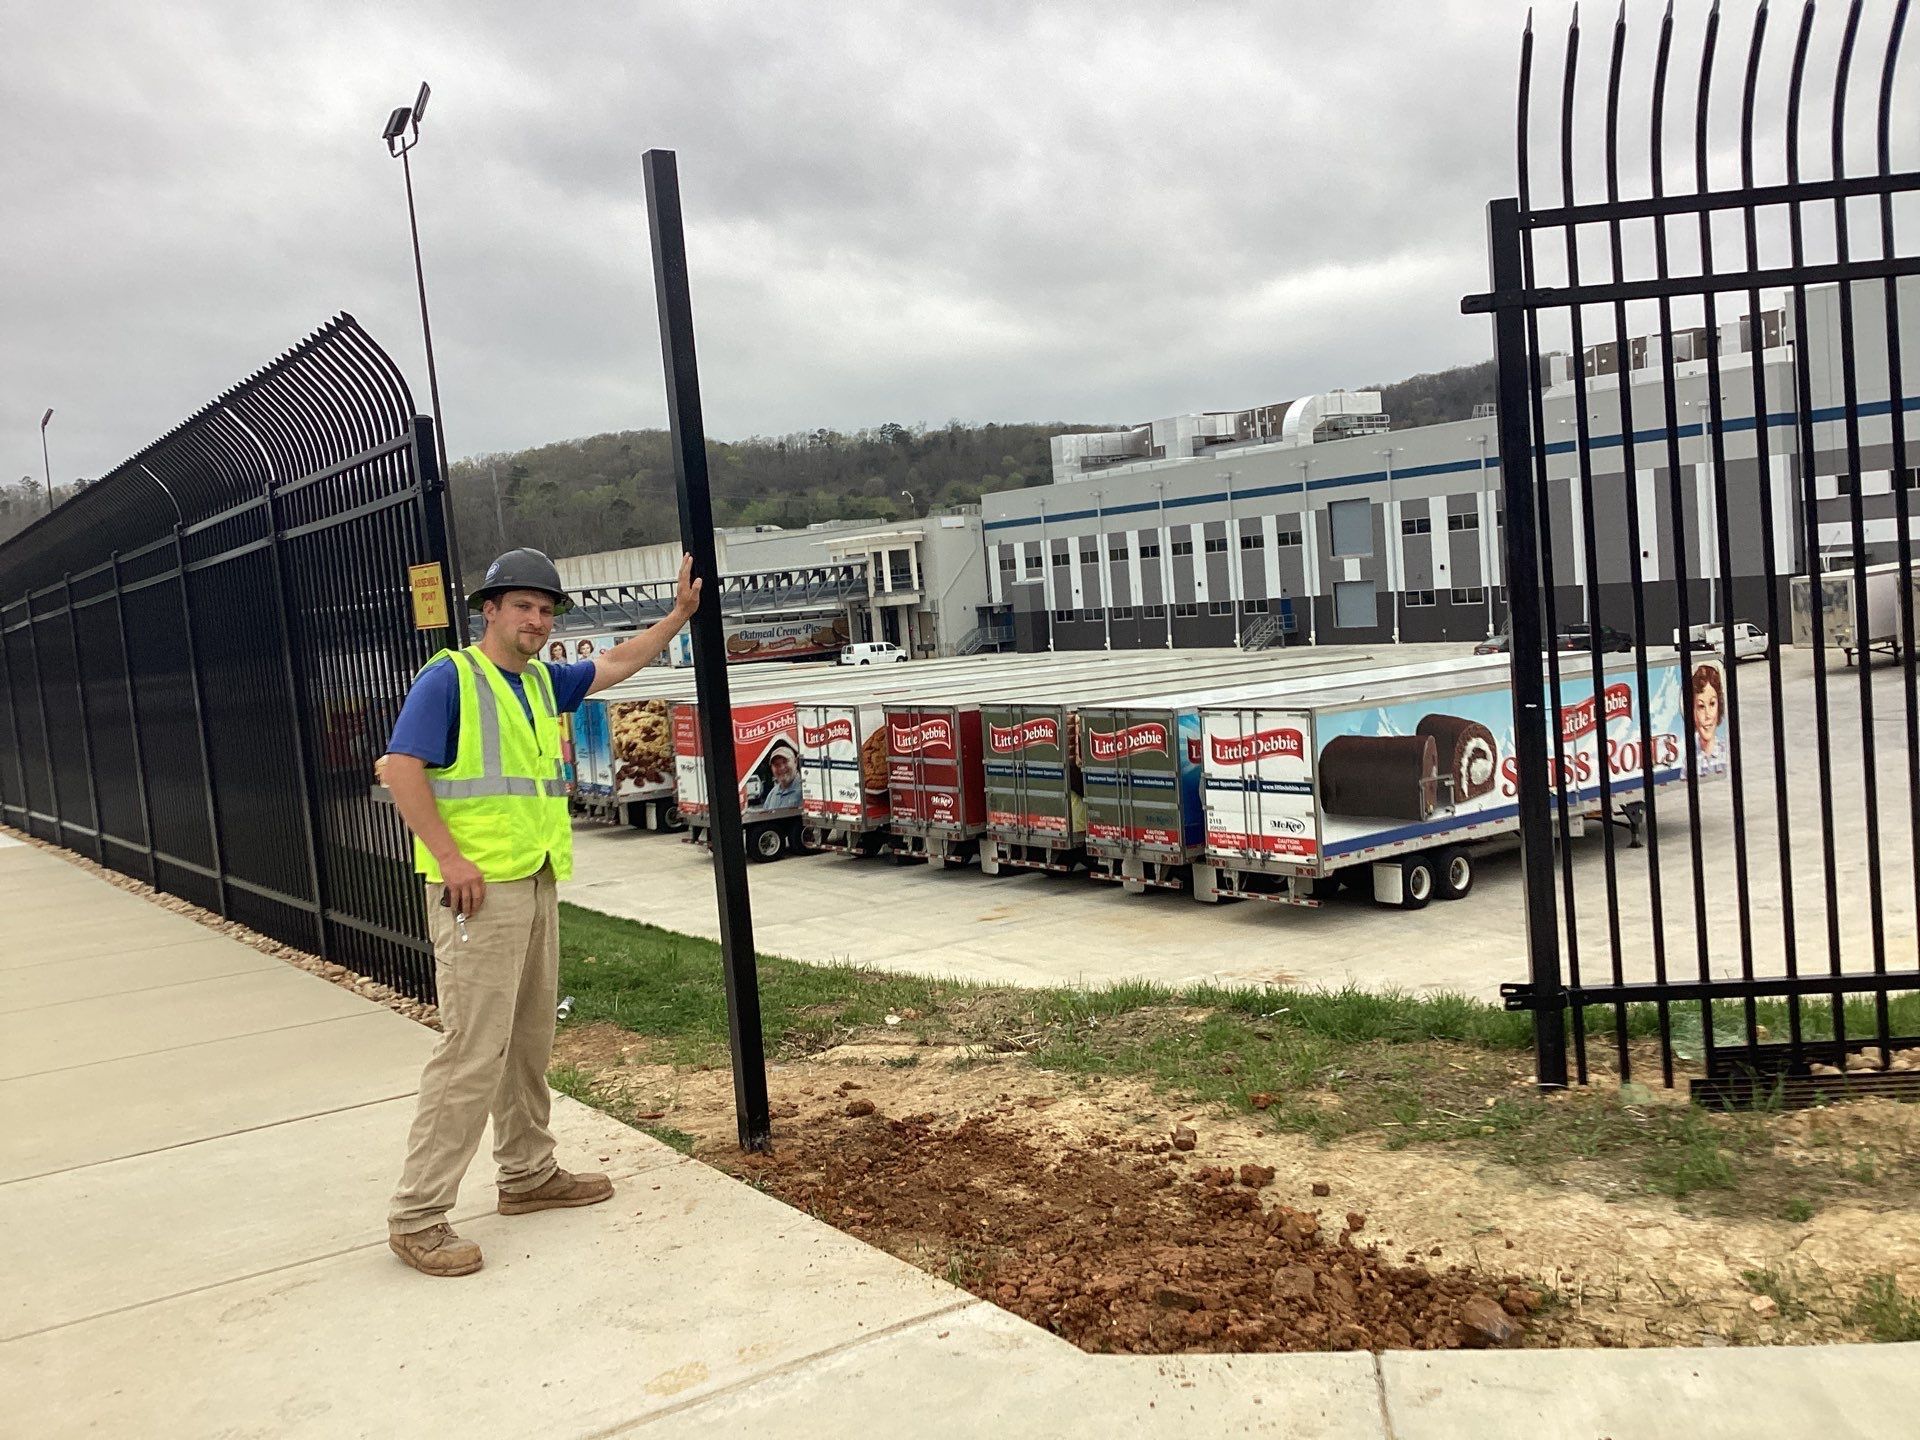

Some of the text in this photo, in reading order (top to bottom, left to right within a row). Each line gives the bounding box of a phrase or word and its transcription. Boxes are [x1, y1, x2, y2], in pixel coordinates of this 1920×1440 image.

[739, 623, 821, 641] Oatmeal Creme Pies
[738, 713, 797, 740] Little Debbi
[896, 734, 918, 747] Litte
[994, 734, 1019, 747] Litte
[1094, 740, 1123, 754] Litte
[1215, 743, 1250, 760] Little
[1251, 735, 1298, 755] Debbie
[1501, 752, 1590, 797] SISS
[1270, 820, 1302, 833] McKee
